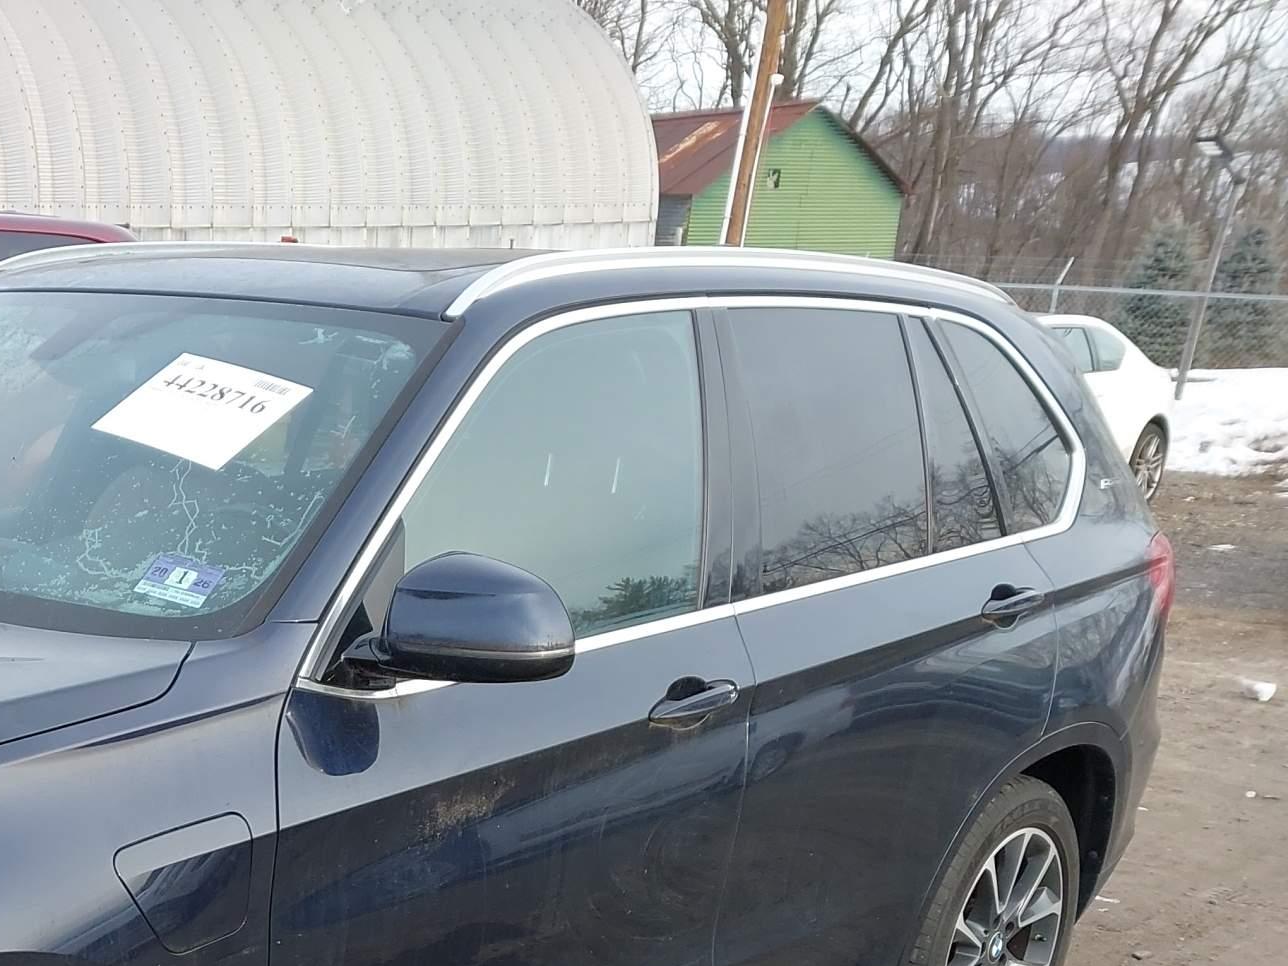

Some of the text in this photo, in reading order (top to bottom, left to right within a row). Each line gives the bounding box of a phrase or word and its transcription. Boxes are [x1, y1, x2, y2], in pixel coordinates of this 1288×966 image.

[163, 374, 271, 414] 44228716
[151, 566, 212, 589] 20 1 26
